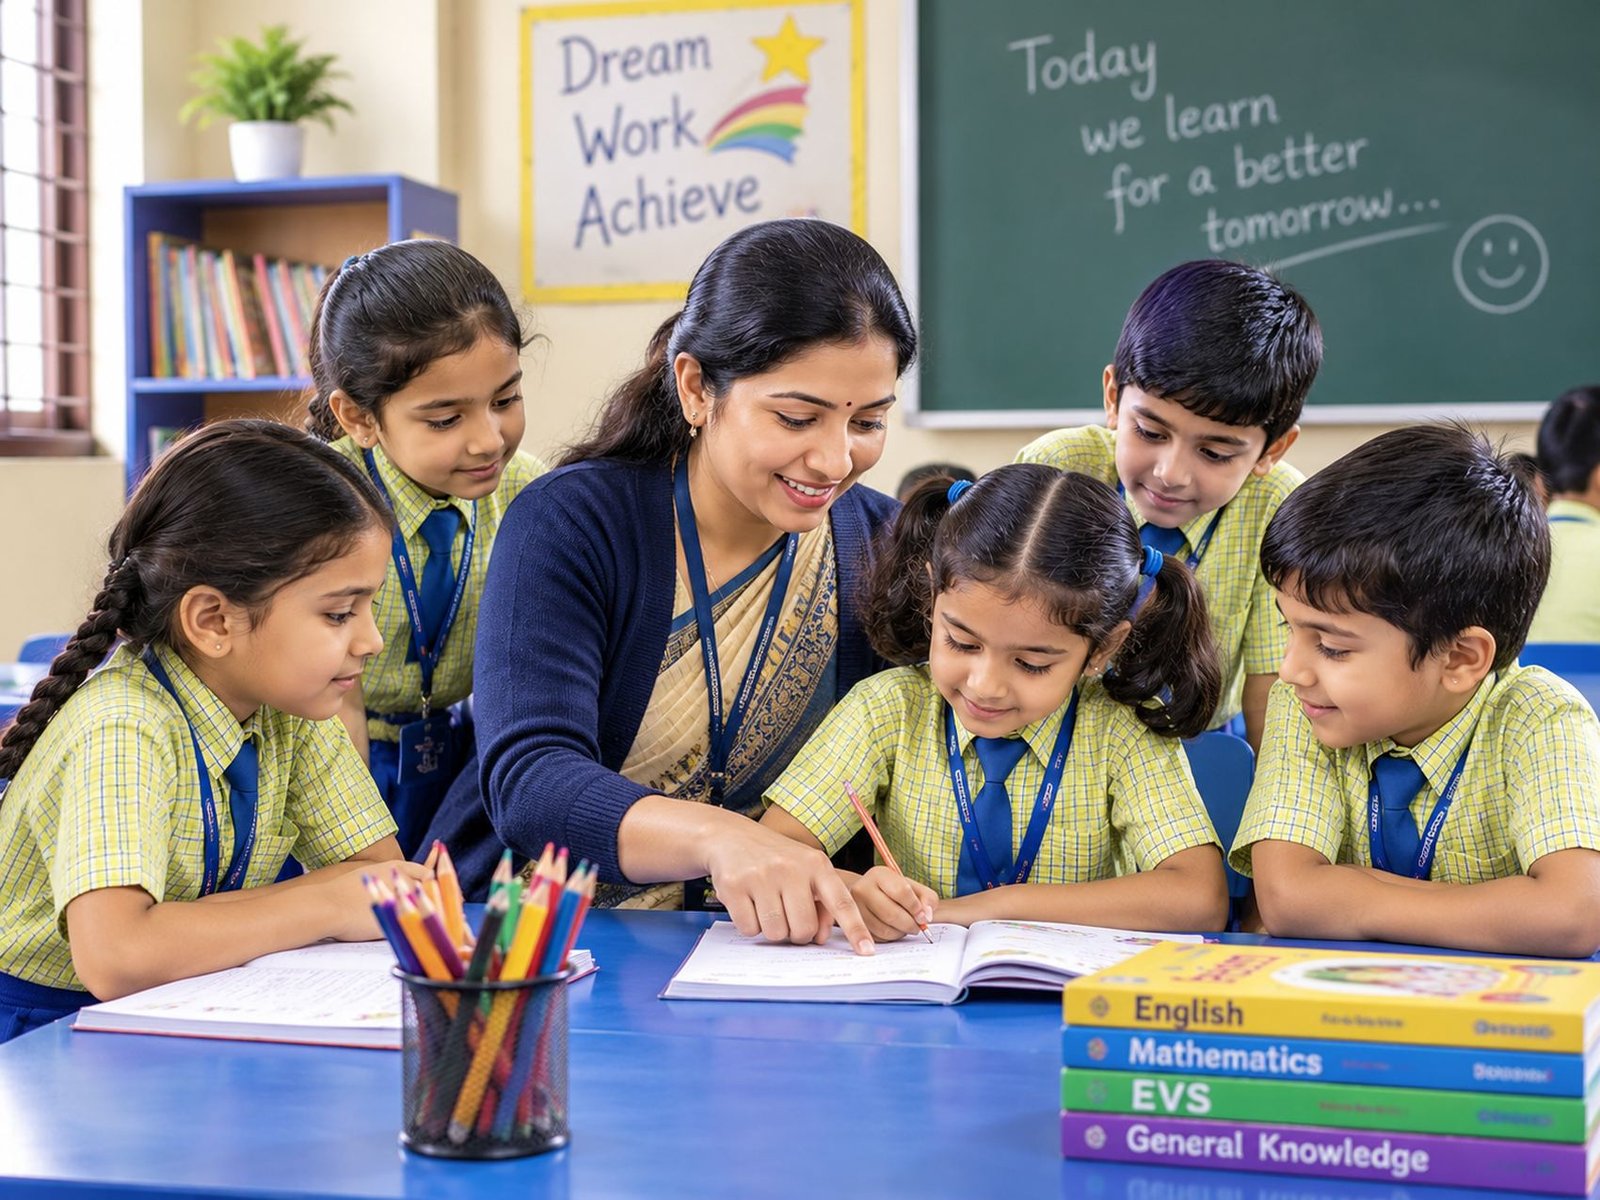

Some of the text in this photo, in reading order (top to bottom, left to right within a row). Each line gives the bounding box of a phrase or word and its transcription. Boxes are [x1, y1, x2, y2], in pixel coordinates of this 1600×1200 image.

[560, 34, 712, 95] Dream
[1007, 29, 1157, 101] Today
[573, 93, 700, 166] Work
[1081, 93, 1279, 155] we learn
[574, 174, 762, 250] Achieve
[1104, 133, 1369, 234] for a better
[1135, 995, 1244, 1031] English
[1128, 1037, 1323, 1076] Mathematics
[1131, 1079, 1213, 1114] EVS
[1126, 1124, 1430, 1178] General Knowledge
